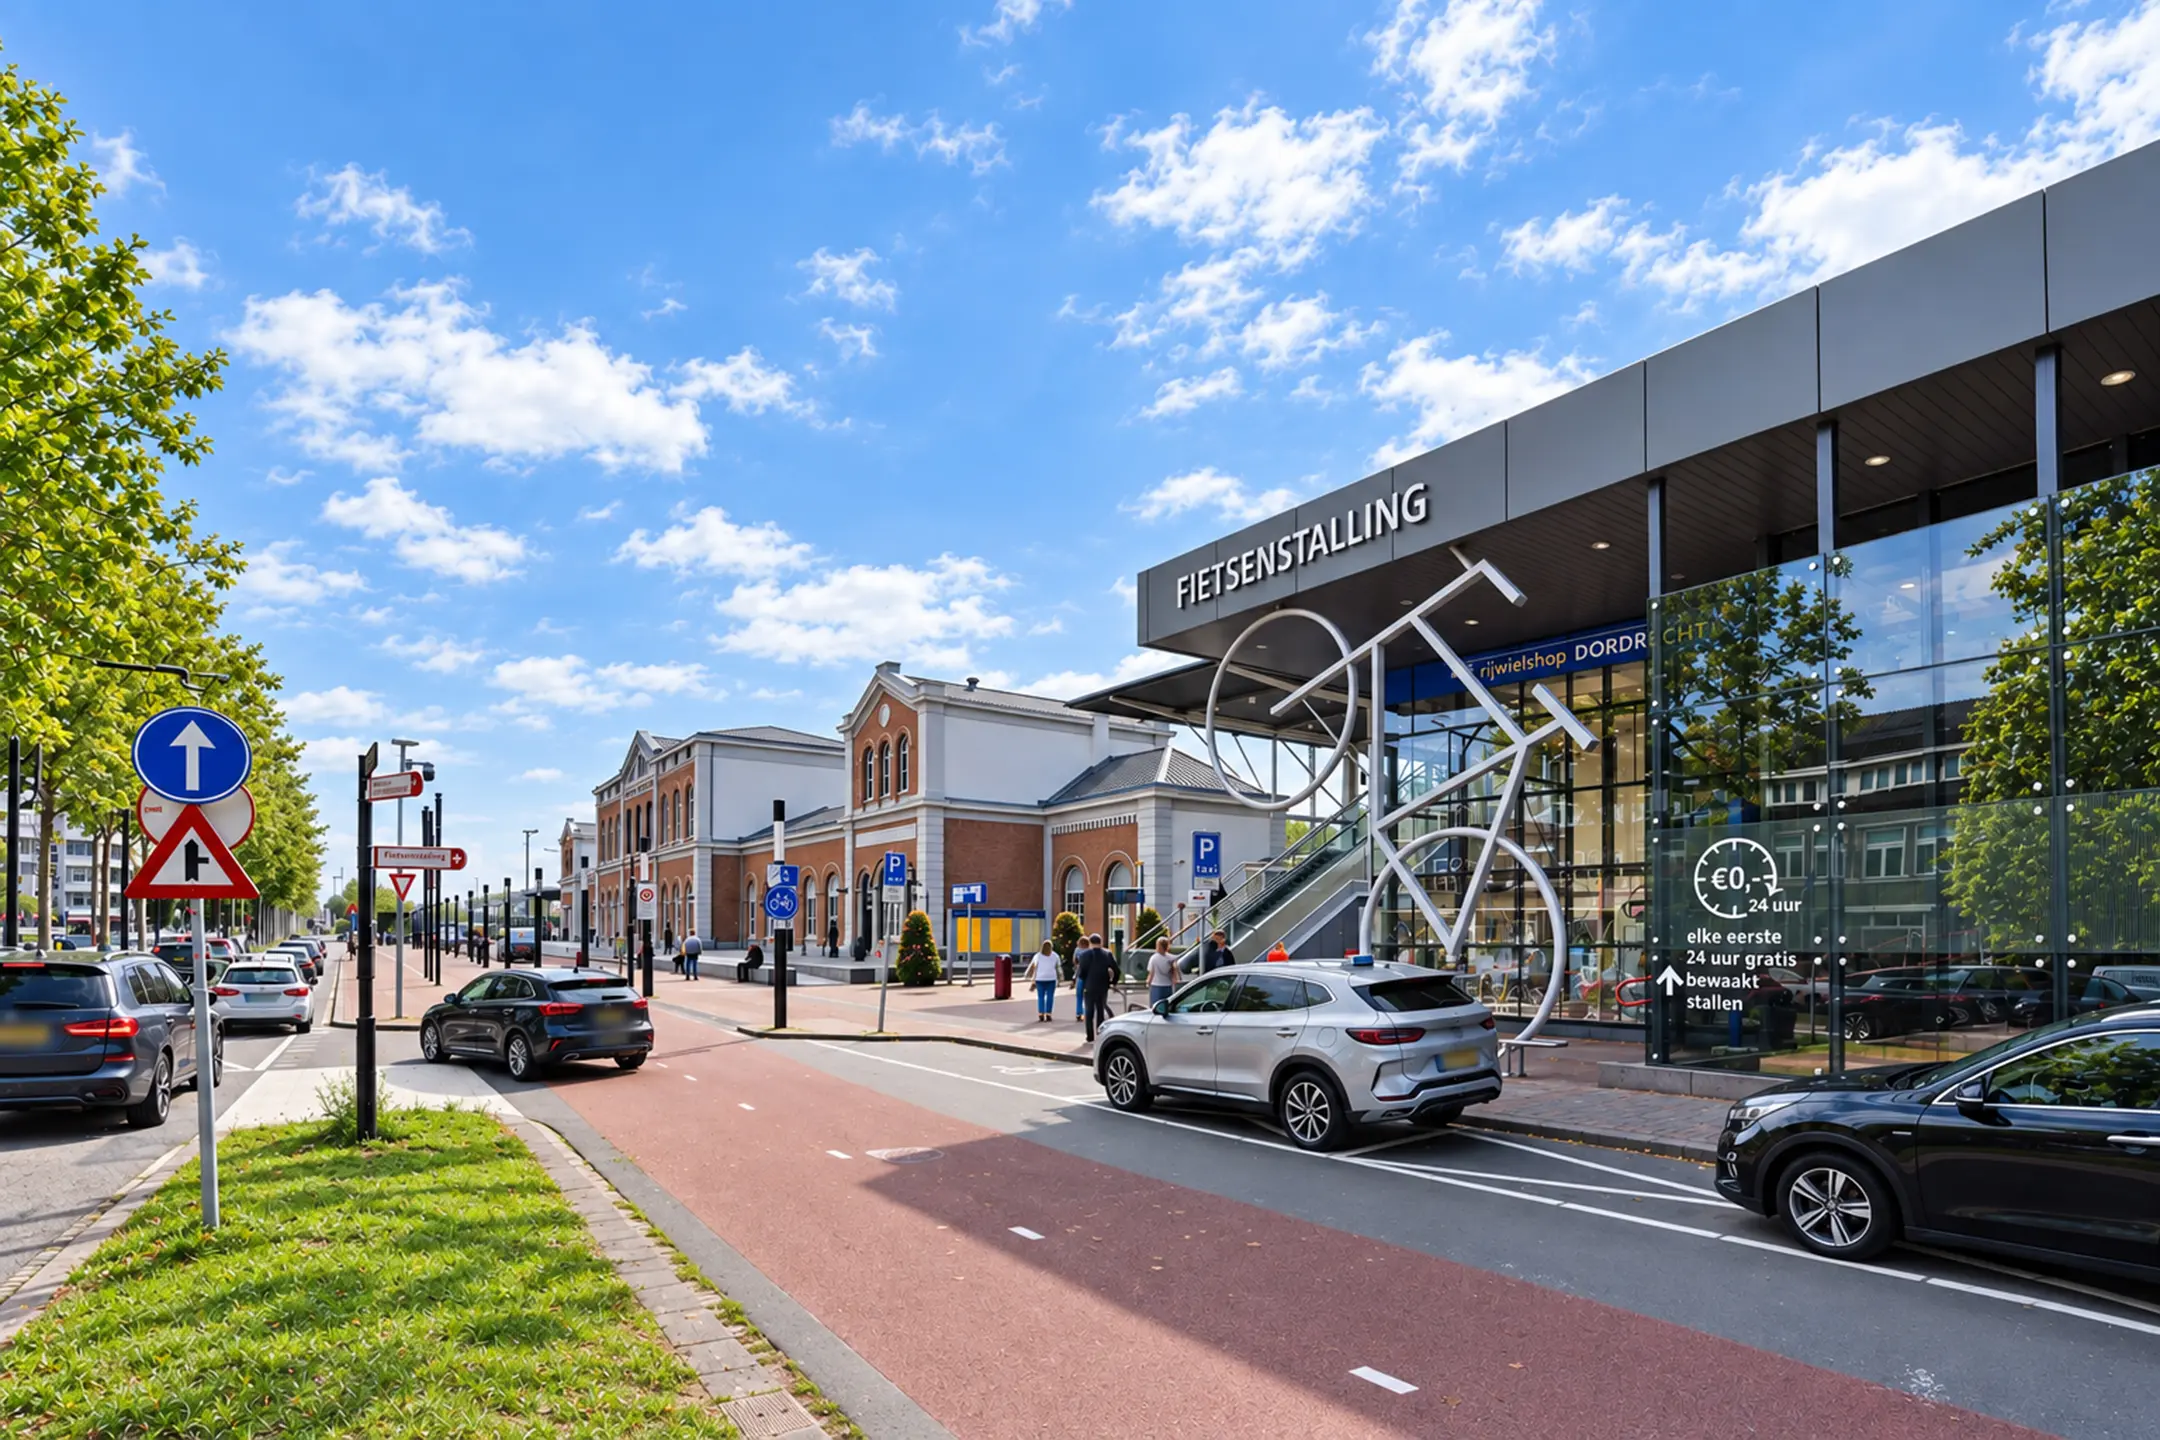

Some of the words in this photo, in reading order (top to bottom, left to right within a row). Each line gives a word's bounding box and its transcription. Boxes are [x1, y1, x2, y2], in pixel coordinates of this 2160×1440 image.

[1176, 482, 1428, 609] FIETSENSTALLING
[1480, 651, 1567, 681] rijwielshop
[1199, 837, 1215, 860] P
[889, 855, 902, 873] P
[1711, 866, 1761, 893] €0,-
[1748, 899, 1769, 912] 24
[1773, 900, 1803, 912] uur
[1686, 928, 1722, 944] elke
[1727, 929, 1782, 944] eerste
[1686, 950, 1706, 965] 24
[1711, 952, 1740, 965] uur
[1745, 951, 1797, 970] gratis
[1686, 972, 1760, 989] bewaakt
[1686, 995, 1744, 1011] stallen
